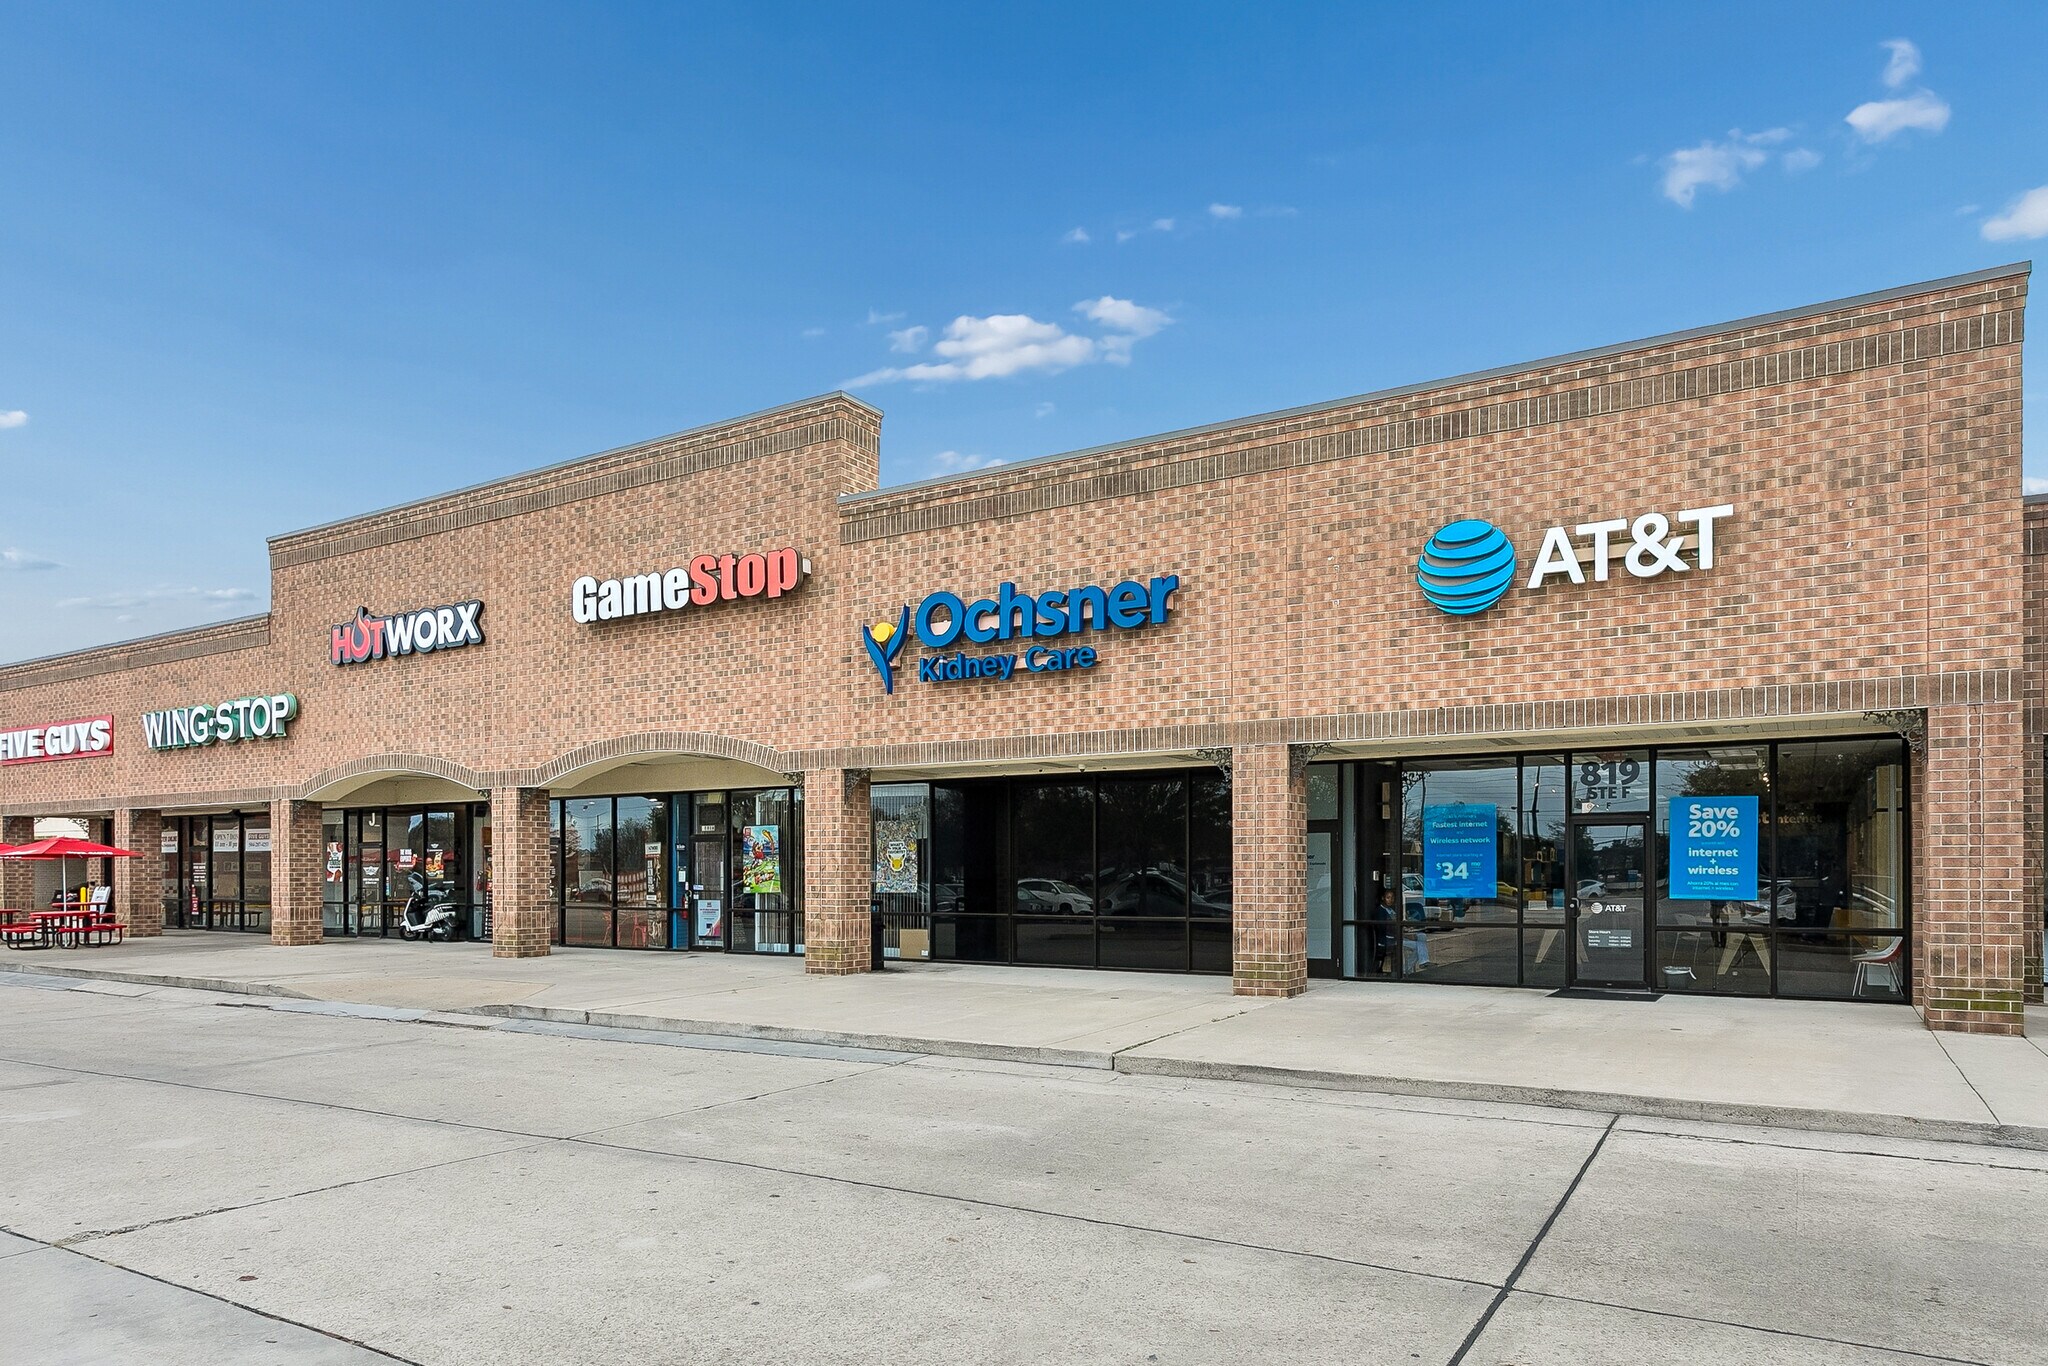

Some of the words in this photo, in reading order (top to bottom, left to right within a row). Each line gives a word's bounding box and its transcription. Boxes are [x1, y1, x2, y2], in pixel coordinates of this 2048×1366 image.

[1526, 503, 1734, 590] AT&T
[571, 546, 800, 625] GameStop
[914, 574, 1179, 648] Ochsner
[331, 601, 481, 664] HOTWORX
[919, 652, 1016, 683] Kidney
[1025, 645, 1098, 673] Care
[0, 727, 45, 762] FIVE
[45, 719, 111, 756] GUYS
[1580, 760, 1641, 787] 819
[1587, 786, 1617, 799] STE
[1621, 786, 1631, 798] F
[1606, 801, 1612, 809] F
[1689, 803, 1739, 820] Save
[1432, 821, 1458, 829] Fastest
[1777, 813, 1823, 824] nternet
[1688, 819, 1741, 838] 20%
[1688, 847, 1739, 857] internet
[1436, 861, 1469, 880] $34
[1688, 865, 1739, 875] wireless
[1604, 904, 1627, 912] AT&T
